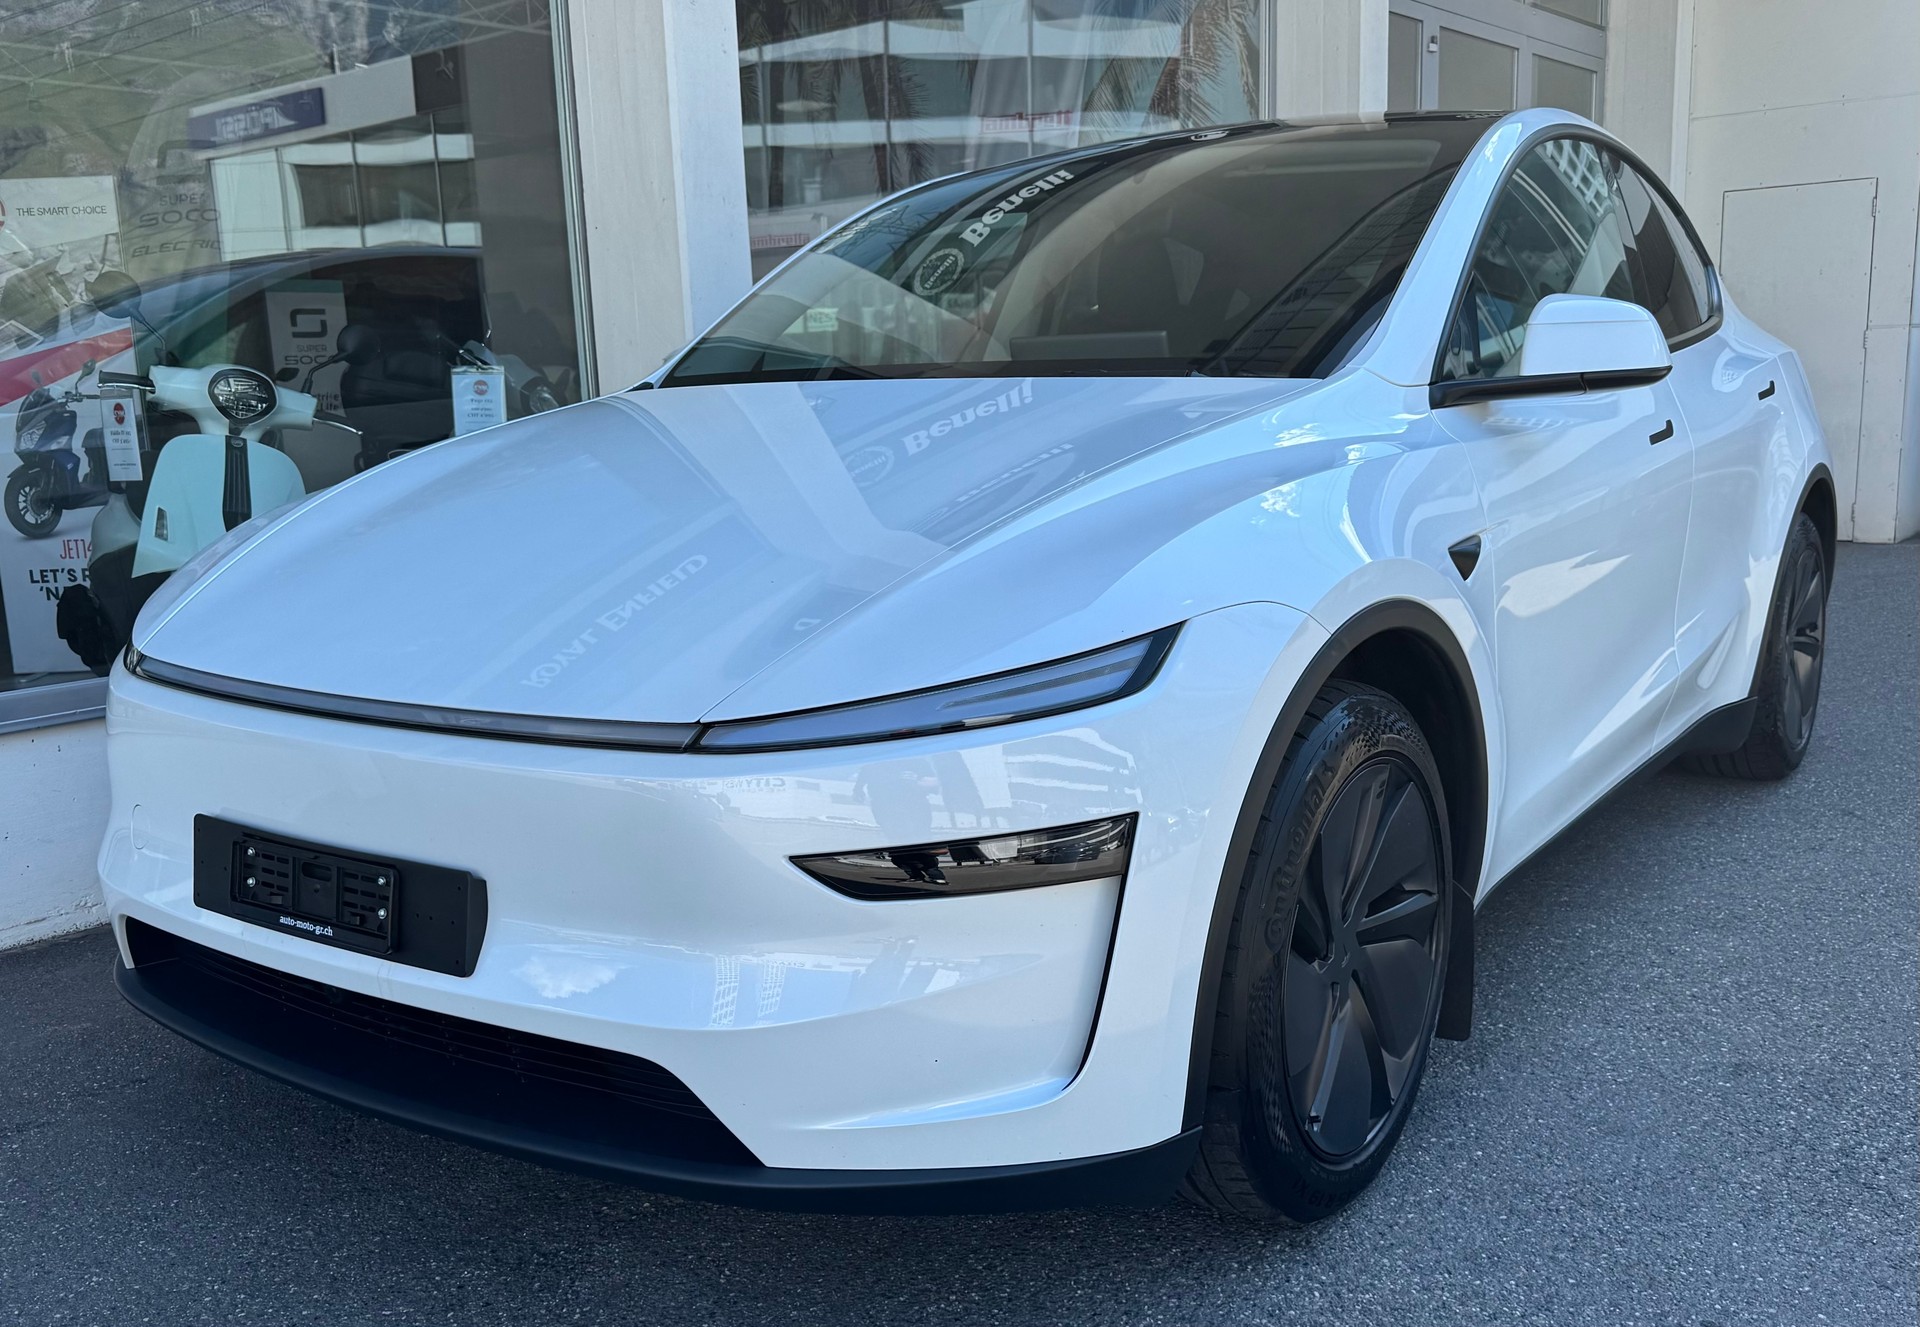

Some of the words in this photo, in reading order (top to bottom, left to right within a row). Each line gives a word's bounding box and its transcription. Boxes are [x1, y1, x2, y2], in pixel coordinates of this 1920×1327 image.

[16, 207, 35, 217] THE
[36, 206, 69, 216] SMART
[71, 205, 107, 215] CHOICE
[296, 344, 328, 353] SUPER
[29, 568, 78, 584] LET'S
[1265, 775, 1327, 951] Continental
[279, 915, 333, 936] auto-moto-gr.ch
